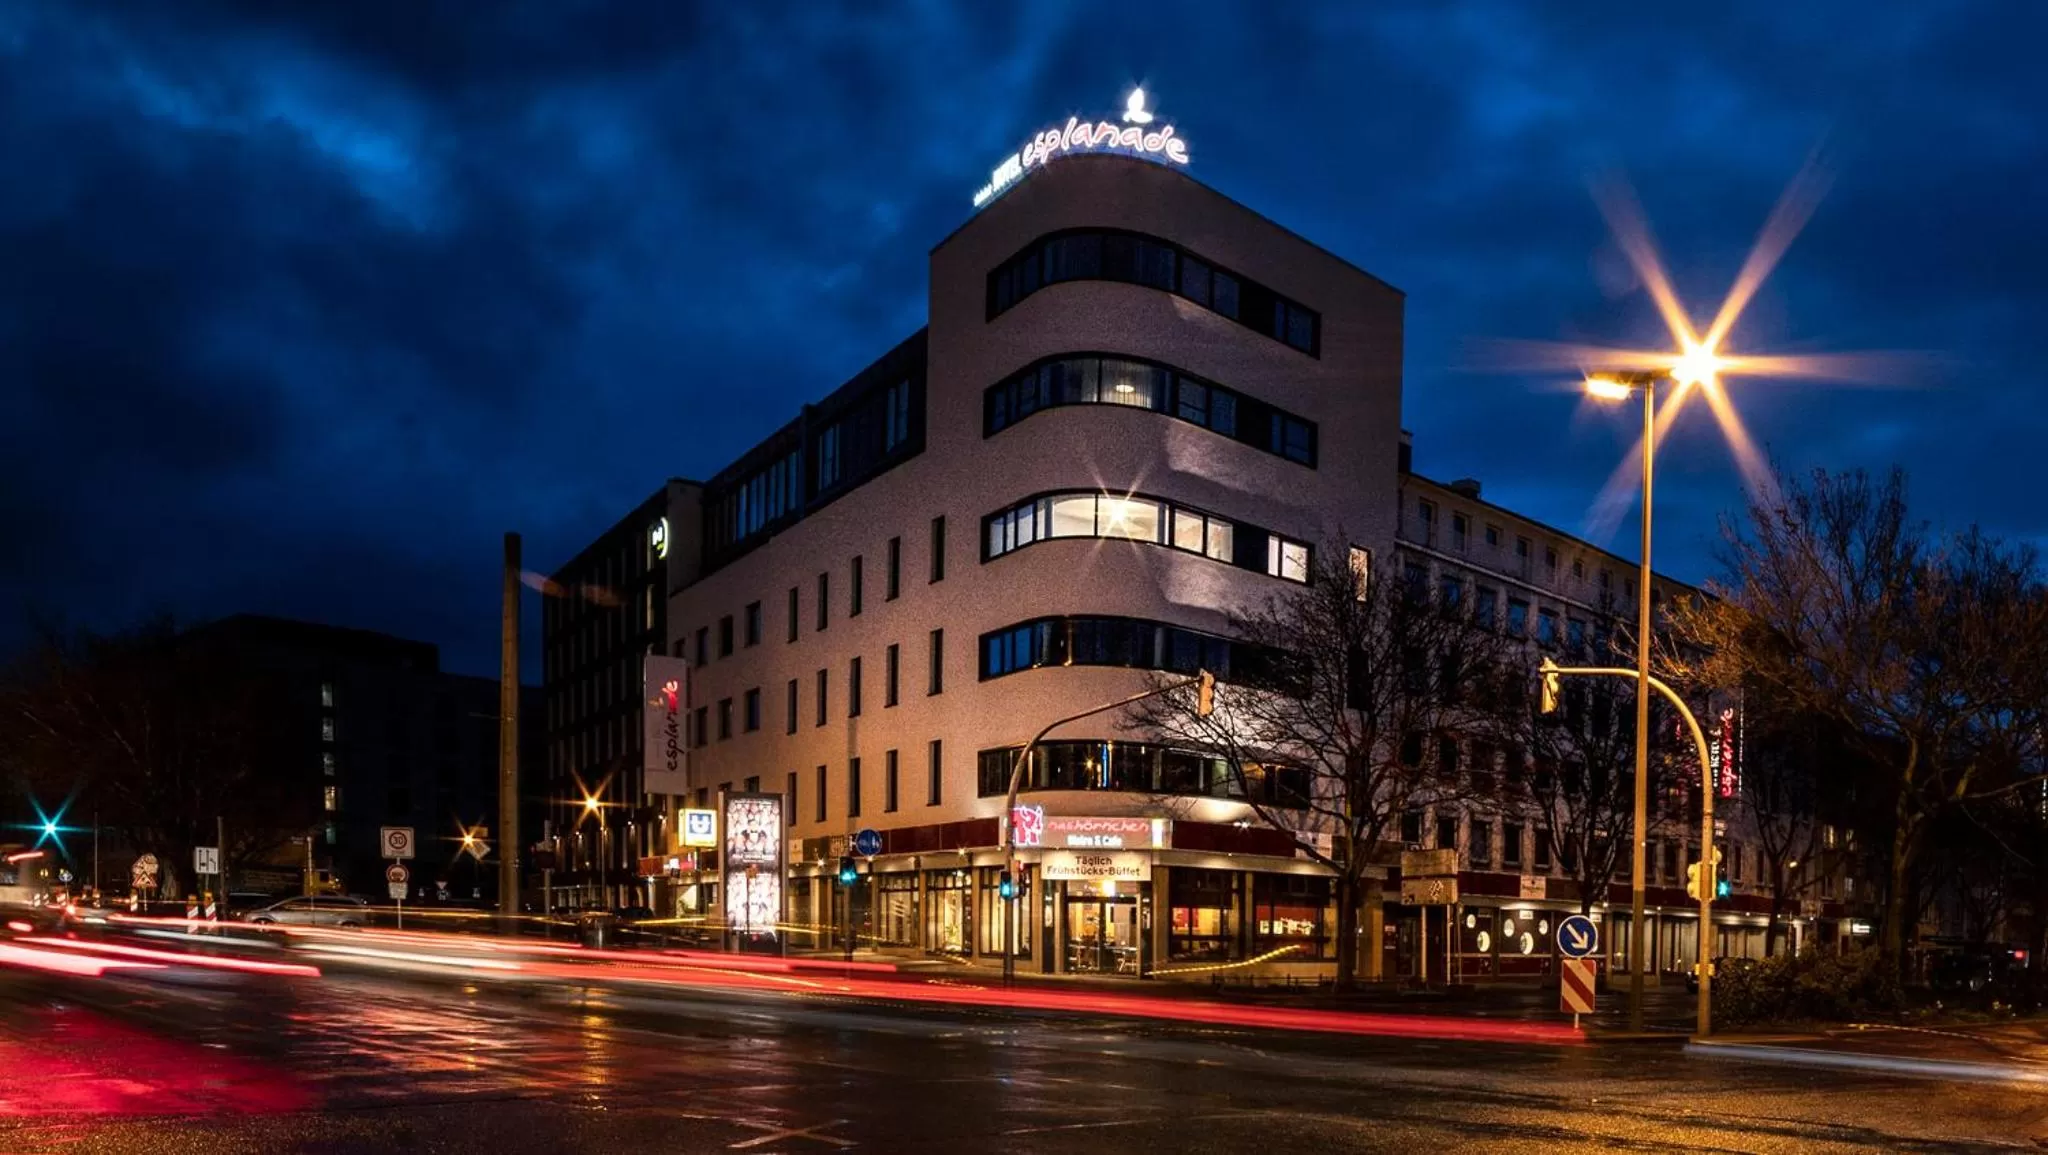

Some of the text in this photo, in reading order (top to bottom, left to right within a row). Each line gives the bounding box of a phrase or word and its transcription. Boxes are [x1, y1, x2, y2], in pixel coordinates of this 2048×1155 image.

[1022, 118, 1188, 165] esplanade
[1720, 708, 1738, 796] esplande
[1075, 856, 1112, 867] Täglich
